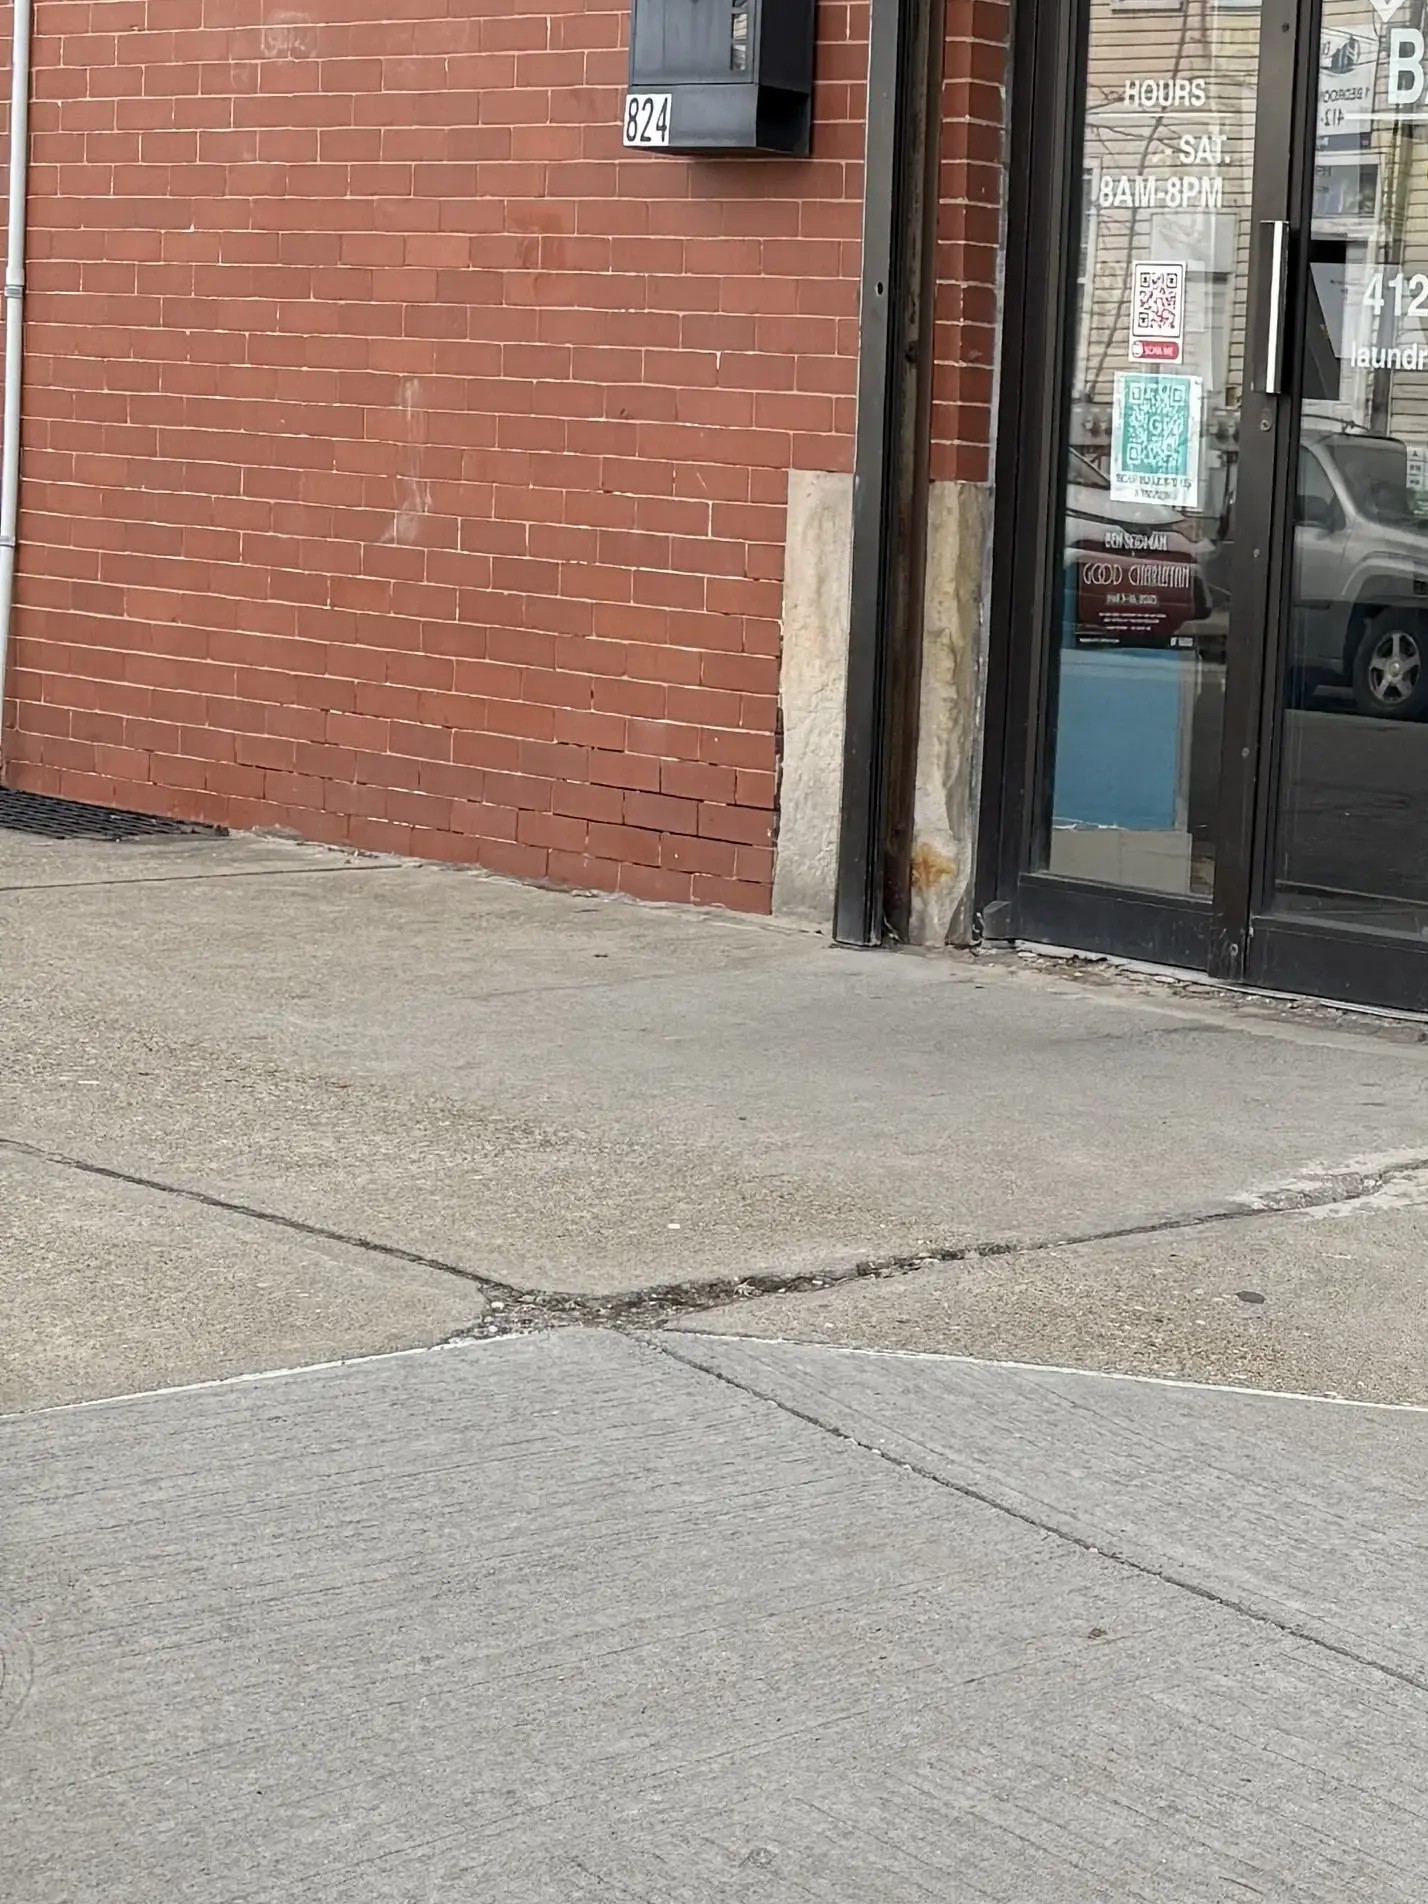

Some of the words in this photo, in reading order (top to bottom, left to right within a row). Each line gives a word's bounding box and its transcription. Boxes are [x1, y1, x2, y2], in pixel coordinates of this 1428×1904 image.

[1124, 79, 1206, 106] HOURS
[626, 96, 668, 143] 824
[1179, 134, 1231, 164] SAT.
[1100, 175, 1223, 208] 8AM-8PM
